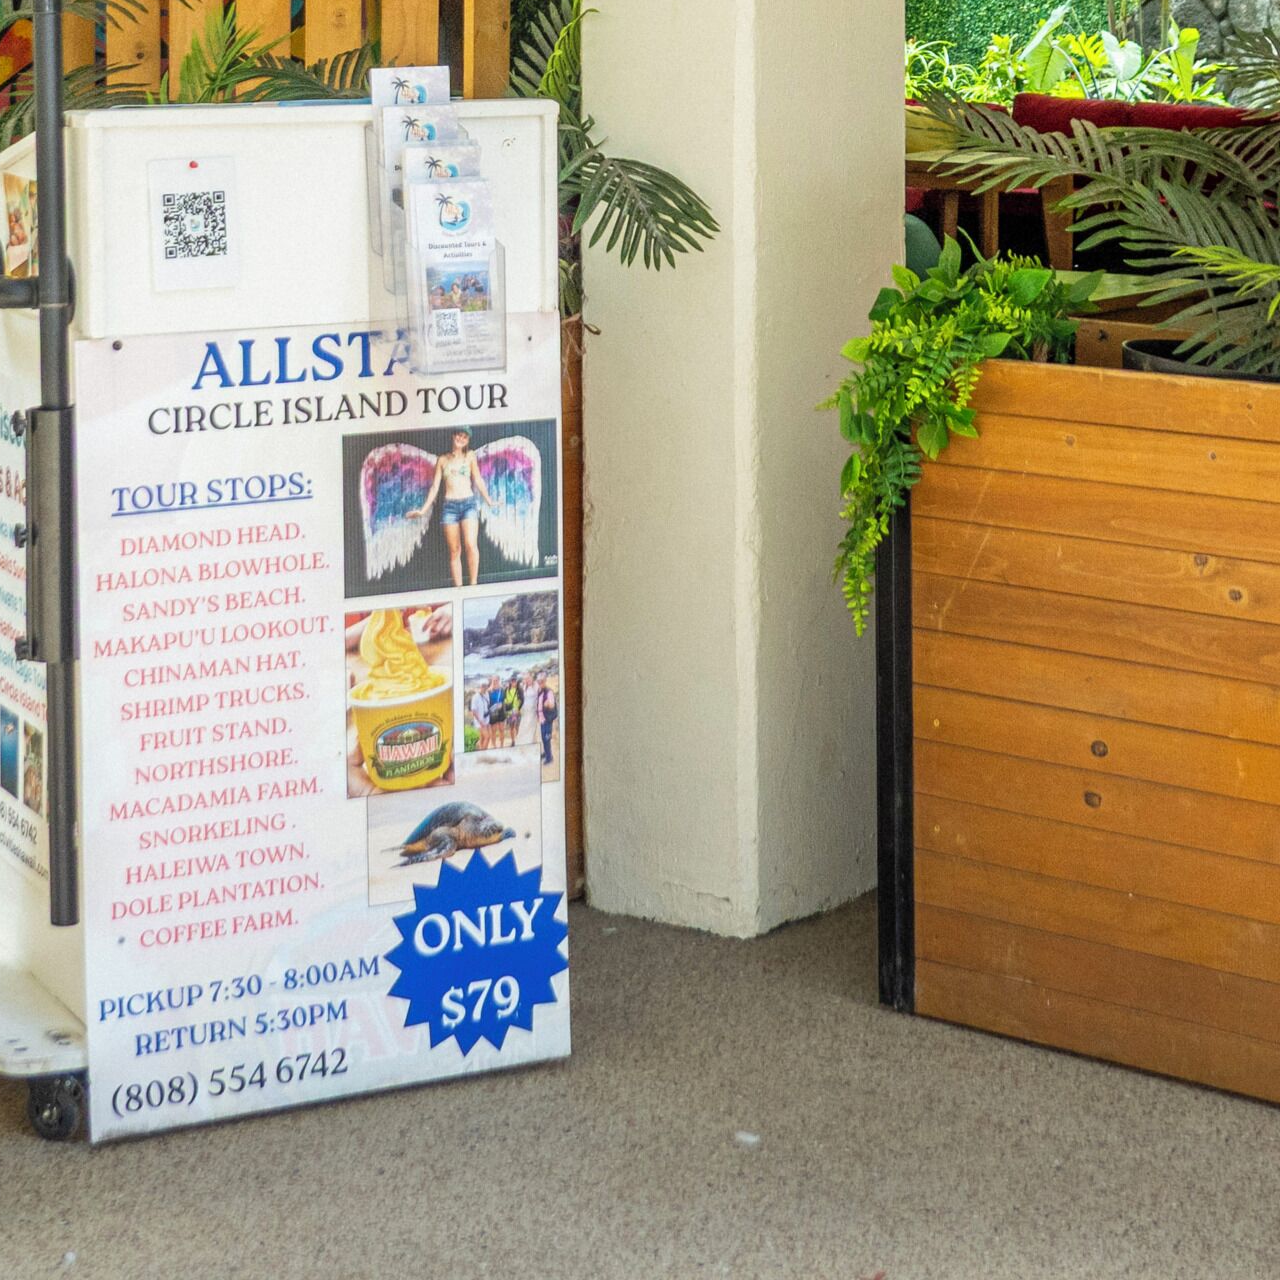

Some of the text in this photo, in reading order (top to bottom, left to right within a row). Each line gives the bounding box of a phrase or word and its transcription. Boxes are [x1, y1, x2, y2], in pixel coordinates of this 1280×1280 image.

[148, 383, 508, 435] CIRCLE ISLAND TOUR
[111, 472, 313, 513] TOUR STOPS:
[121, 523, 306, 558] DIAMOND HEAD.
[96, 552, 330, 592] HALONA BLOWHOLE.
[122, 586, 306, 623] SANDY'S BEACH.
[93, 616, 334, 660] MAKAPU'U LOOKOUT.
[124, 651, 306, 688] CHINAMAN HAT.
[121, 682, 310, 721] SHRIMP TRUCKS.
[140, 717, 293, 752] FRUIT STAND.
[378, 734, 438, 761] HAWAII
[134, 749, 299, 786] NORTHSHORE.
[110, 777, 324, 821] MACADAMIA FARM.
[125, 843, 310, 886] HALEIWA TOWN.
[111, 873, 325, 921] DOLE PLANTATION.
[140, 910, 299, 948] COFFEE FARM.
[413, 898, 544, 956] ONLY
[99, 984, 204, 1021] PICKUP
[210, 974, 263, 1002] 7:30
[283, 956, 382, 989] 8:00AM
[441, 975, 520, 1029] $79
[135, 1000, 348, 1057] RETURN 5:30PM
[111, 1047, 348, 1118] (808) 554 6742
